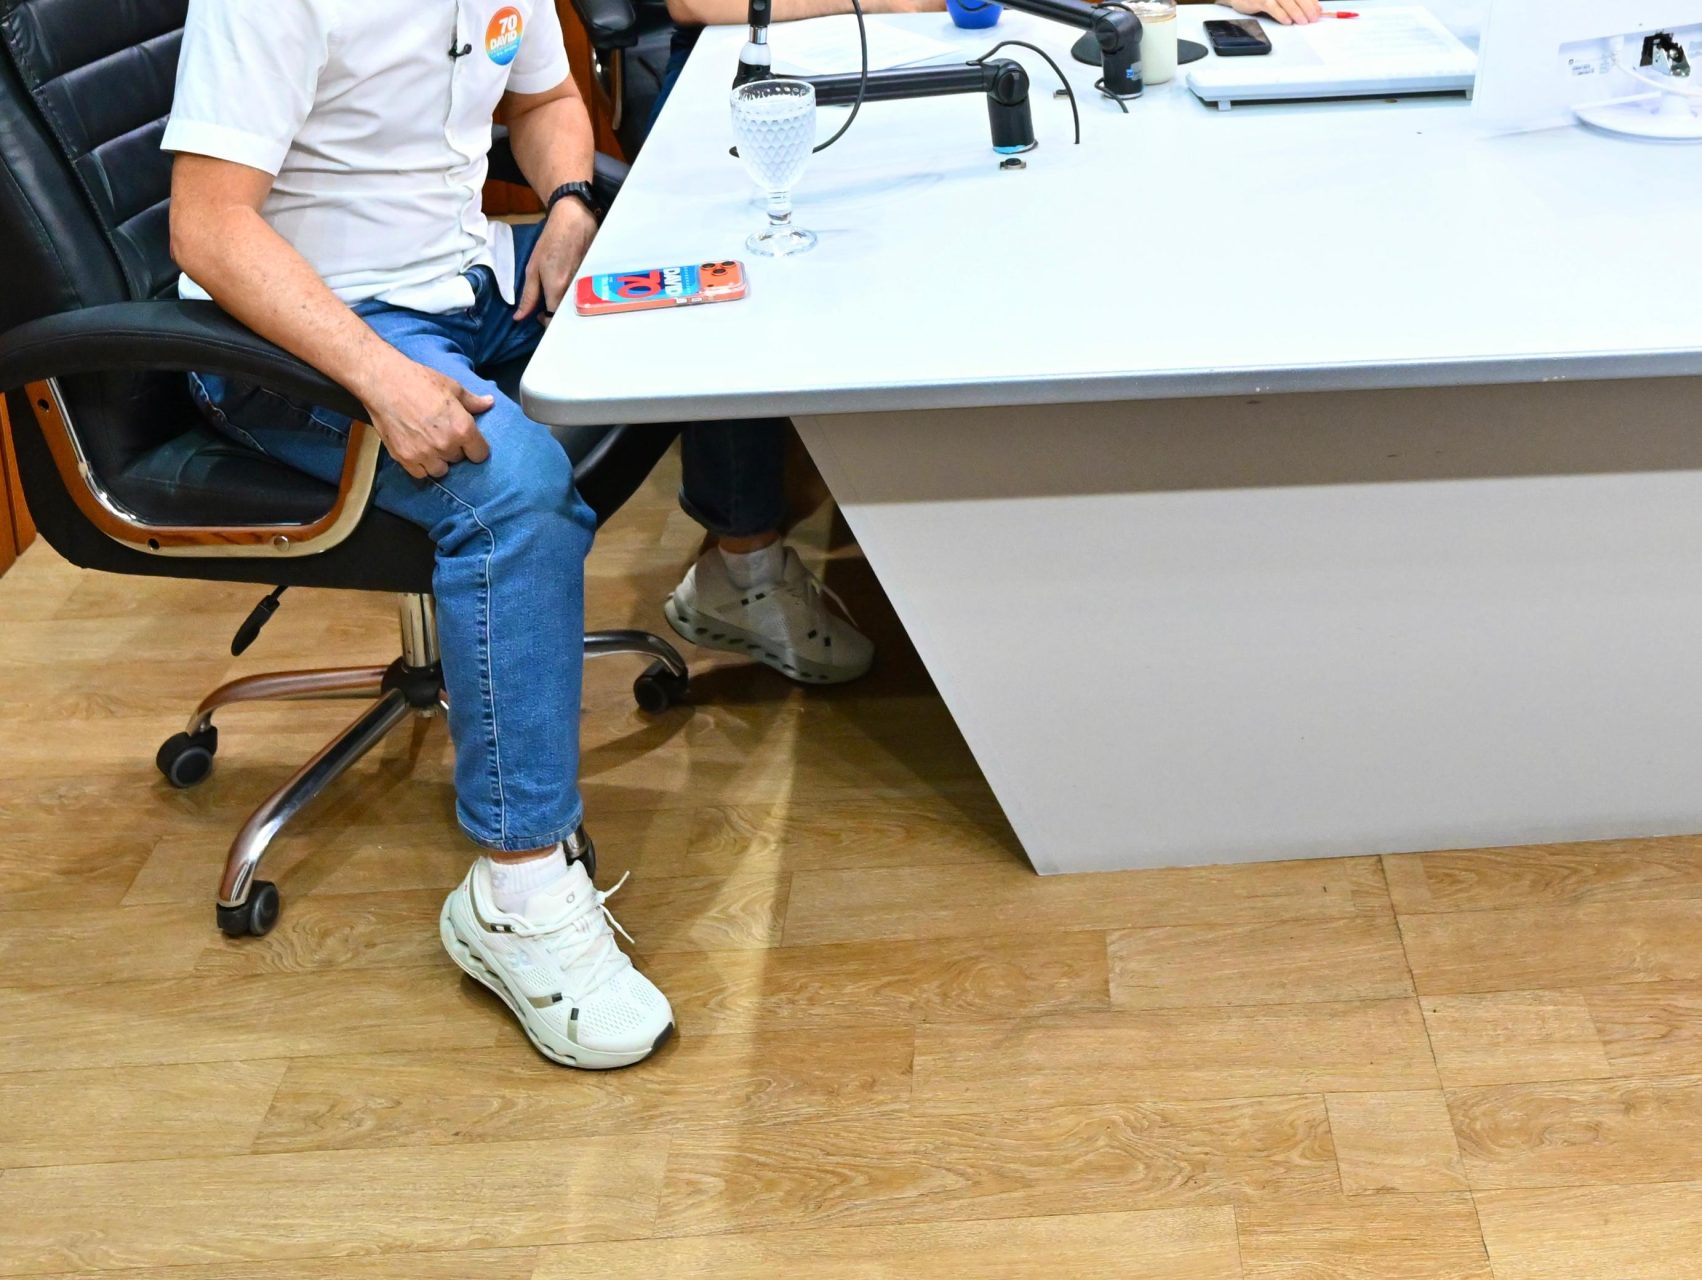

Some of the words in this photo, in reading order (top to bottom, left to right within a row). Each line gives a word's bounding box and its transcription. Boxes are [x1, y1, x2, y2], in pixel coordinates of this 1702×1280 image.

[499, 14, 518, 35] 70
[490, 30, 518, 51] DAVID
[617, 270, 662, 299] 70
[663, 267, 683, 297] DAVID
